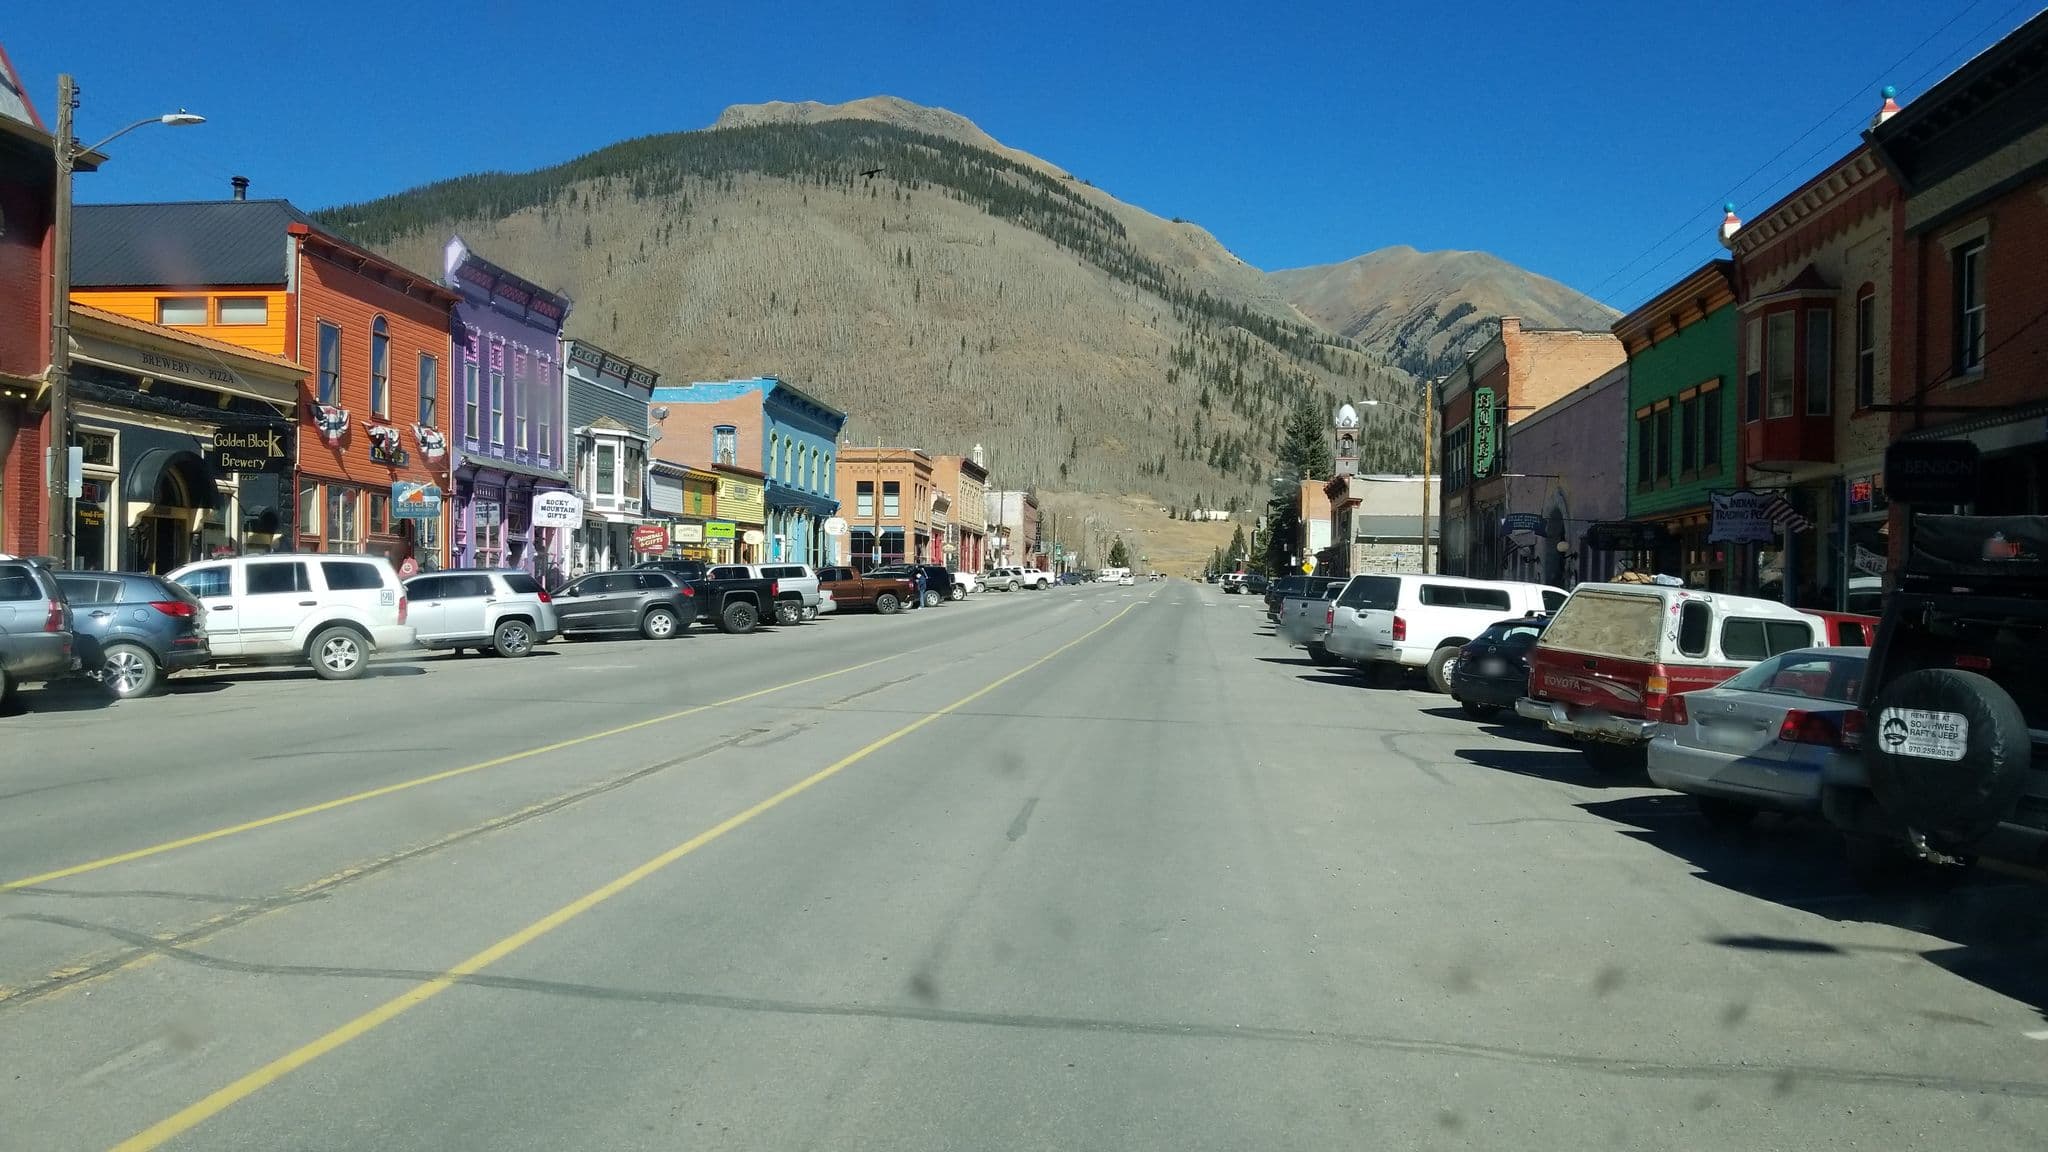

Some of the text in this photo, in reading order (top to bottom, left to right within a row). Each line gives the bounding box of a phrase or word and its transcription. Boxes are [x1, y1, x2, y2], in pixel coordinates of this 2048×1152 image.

[142, 353, 234, 384] BREWERY PIZZA
[214, 433, 246, 448] Golden
[1477, 393, 1492, 474] HOTEL
[222, 453, 266, 469] Brewery
[1904, 458, 1974, 476] BENSON
[540, 505, 576, 513] MOUNTAIN
[1544, 673, 1581, 690] TOYOTA
[1909, 728, 1930, 737] RAFT
[1938, 732, 1959, 740] JEEP
[1910, 720, 1959, 732] SOUTHWEST
